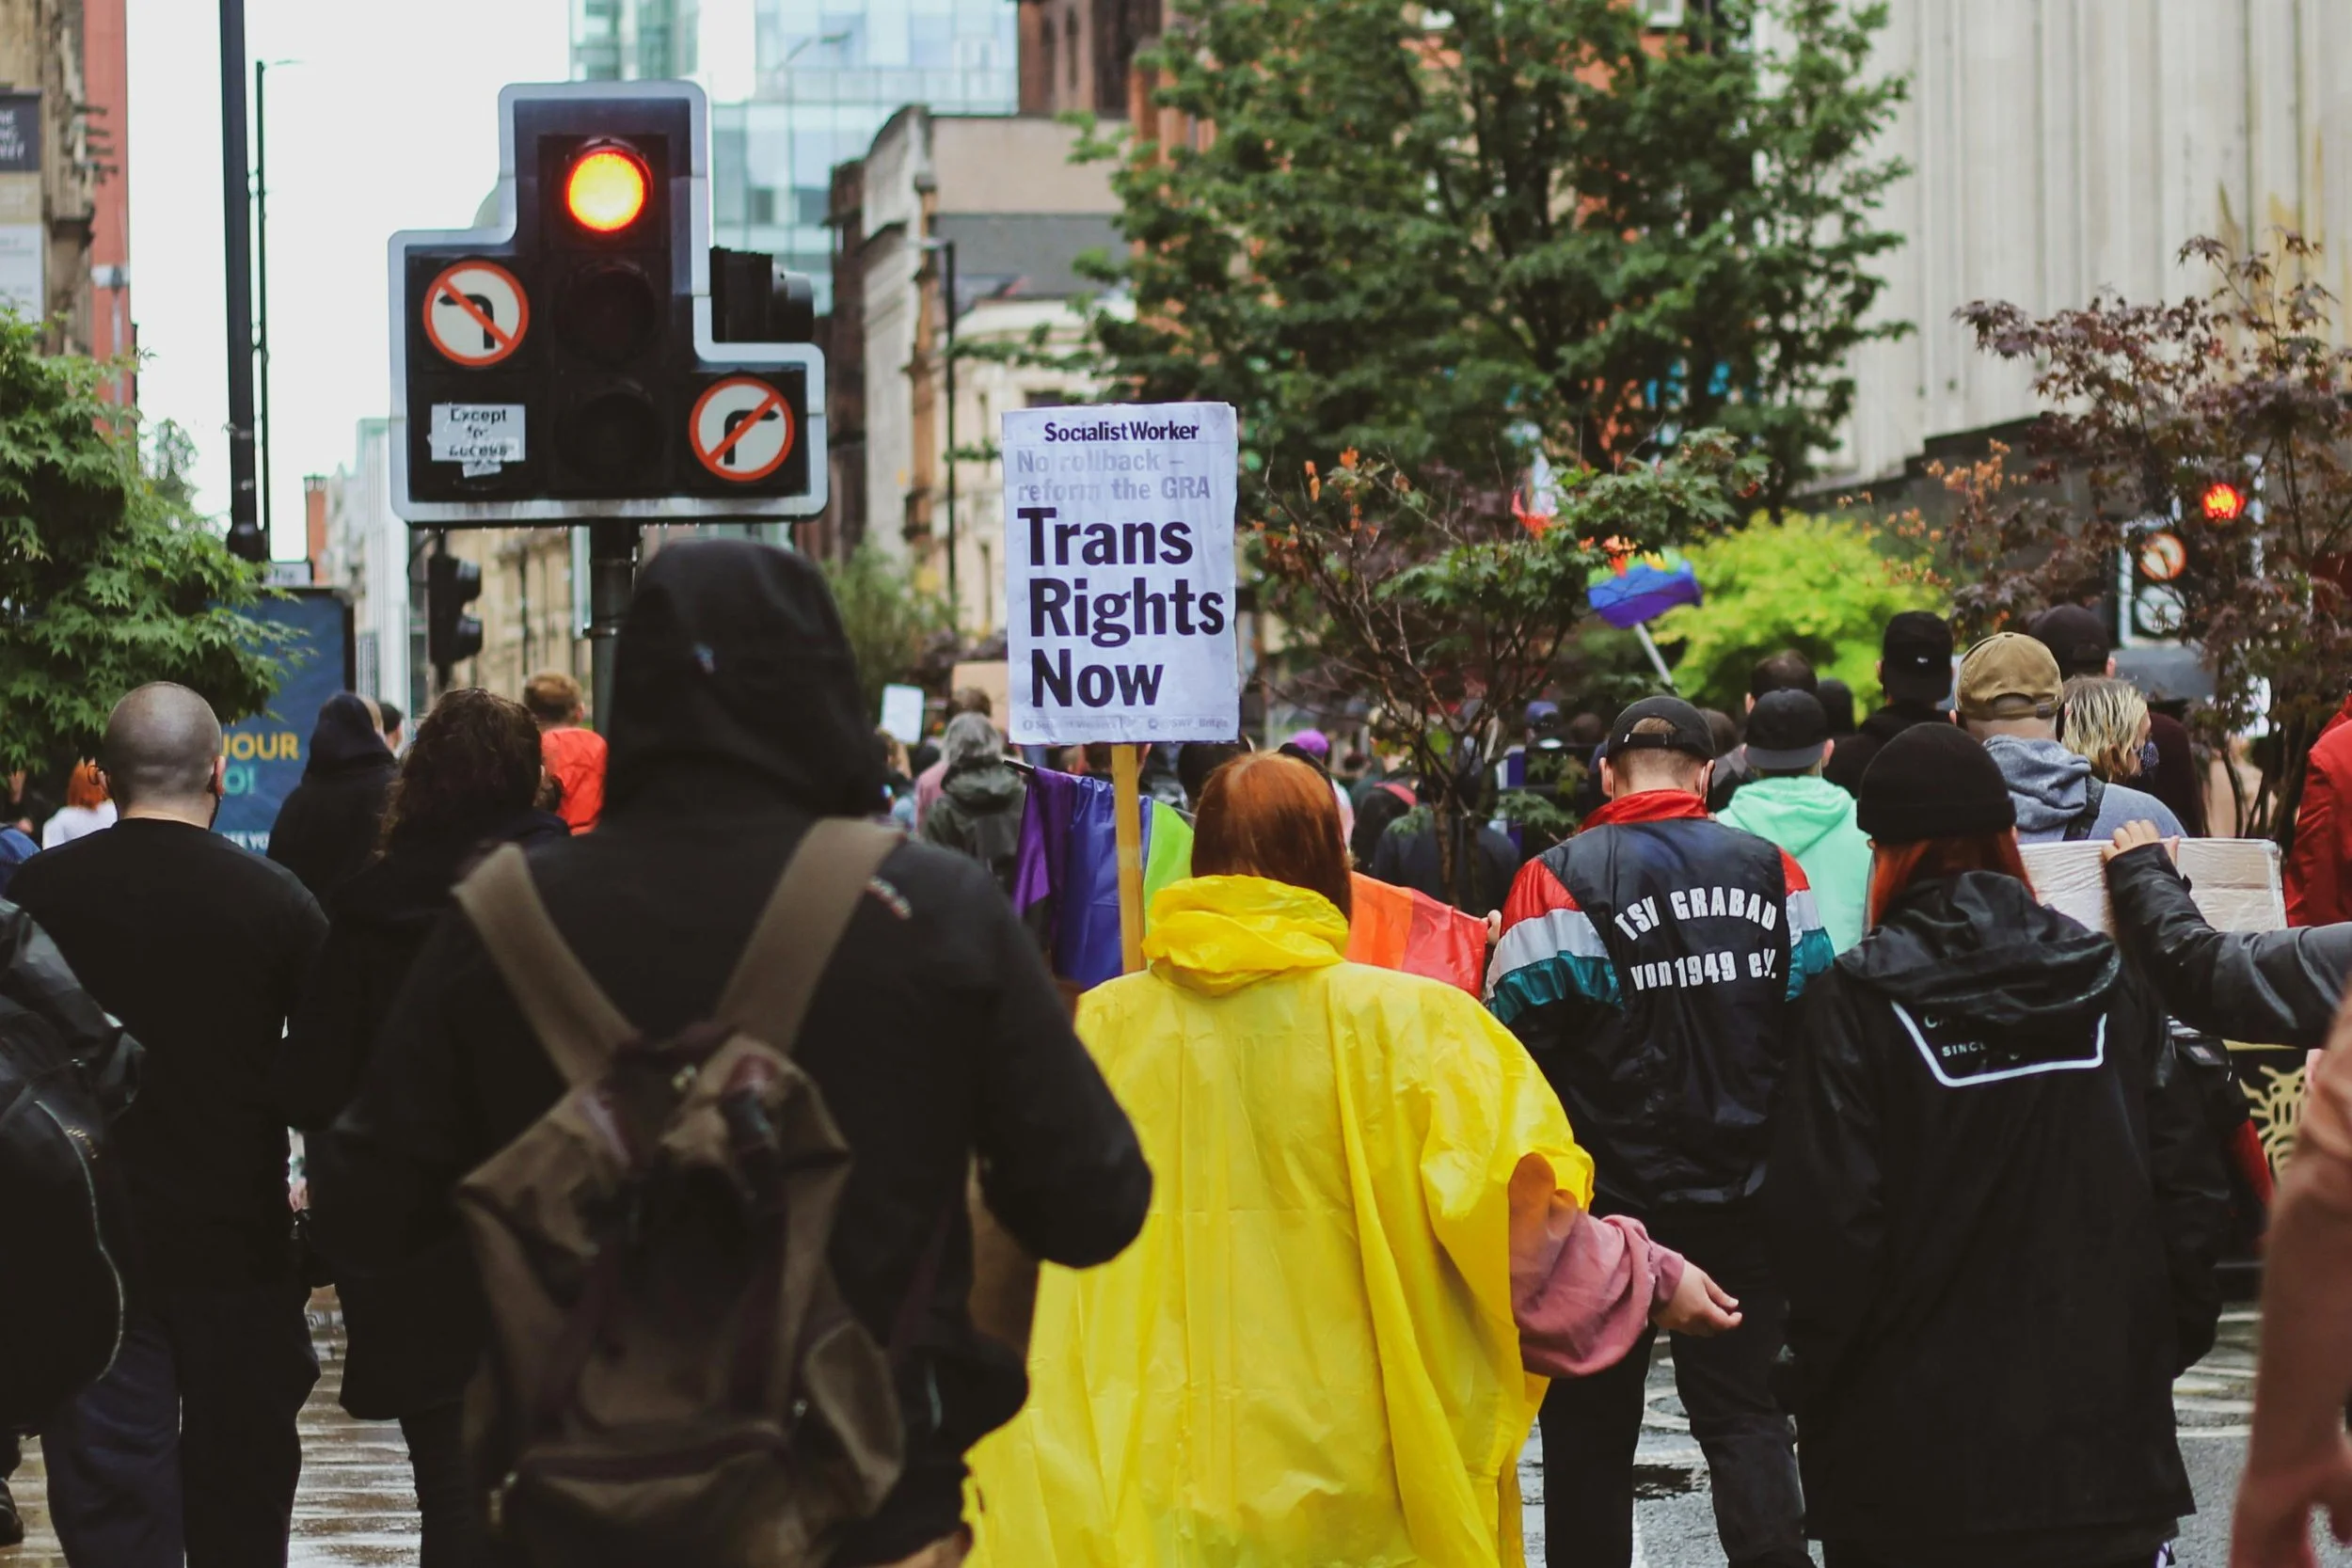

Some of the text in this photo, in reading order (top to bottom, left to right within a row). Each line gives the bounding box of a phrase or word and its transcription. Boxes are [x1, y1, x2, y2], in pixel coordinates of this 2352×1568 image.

[1017, 450, 1050, 472] No
[1059, 449, 1161, 472] rollback
[1018, 476, 1211, 501] reform the GRA
[1017, 507, 1193, 566] Trans
[1029, 577, 1224, 648] Rights
[1031, 648, 1164, 708] Now
[1614, 886, 1777, 941] TSV GRABAU
[1675, 951, 1737, 988] 1949
